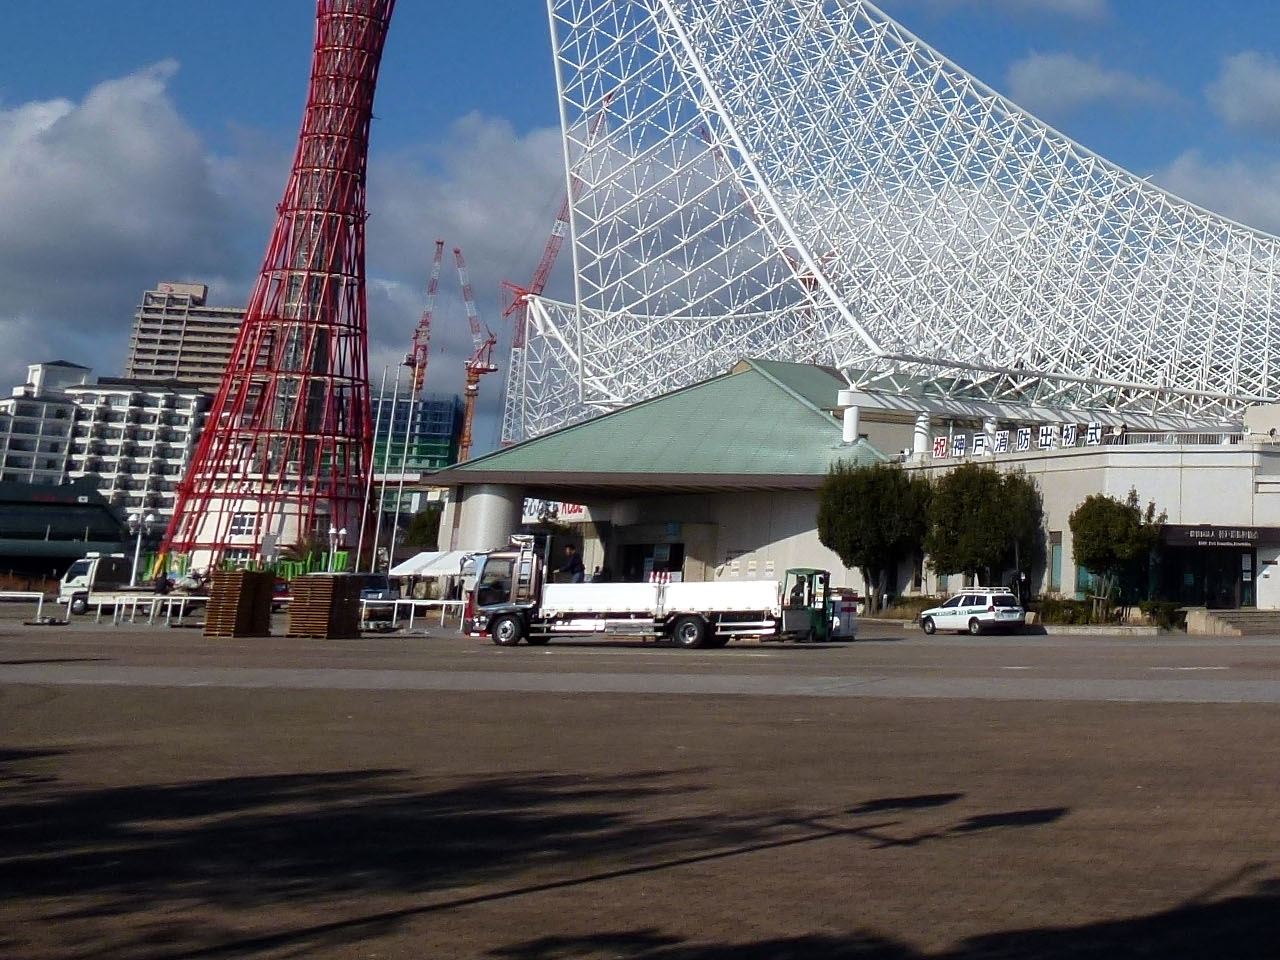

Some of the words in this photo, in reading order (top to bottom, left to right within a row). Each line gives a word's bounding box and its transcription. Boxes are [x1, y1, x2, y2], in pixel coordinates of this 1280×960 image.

[933, 422, 1102, 458] 祝神戸消防出初式
